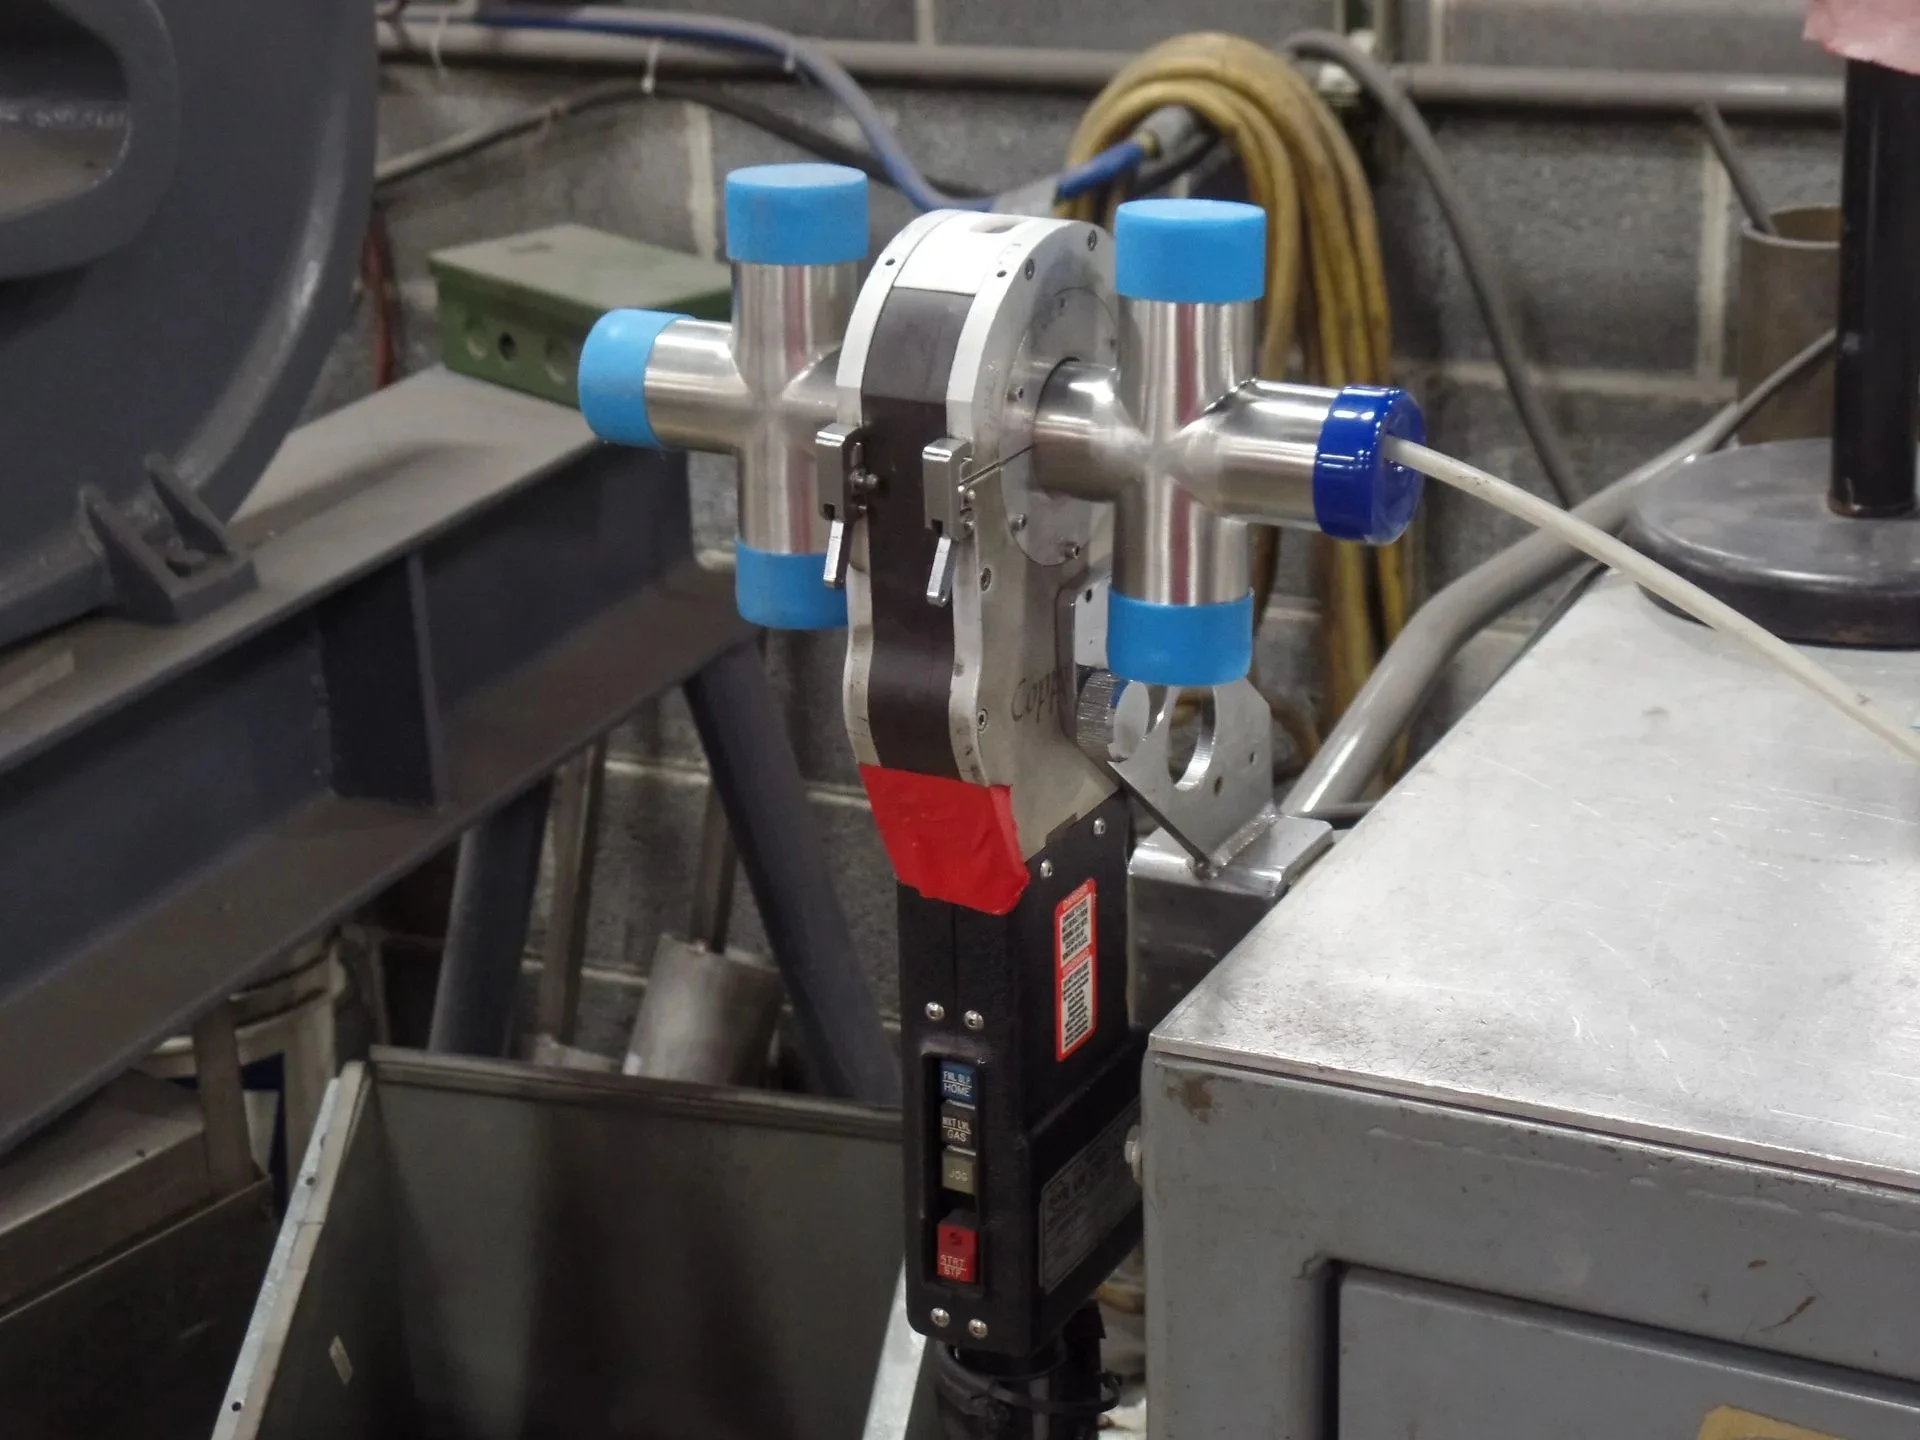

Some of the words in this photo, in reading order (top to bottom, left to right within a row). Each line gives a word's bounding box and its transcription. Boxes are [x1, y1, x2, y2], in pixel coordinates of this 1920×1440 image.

[943, 1083, 970, 1096] HOME
[947, 1129, 967, 1142] GAS
[948, 1169, 968, 1182] JOG
